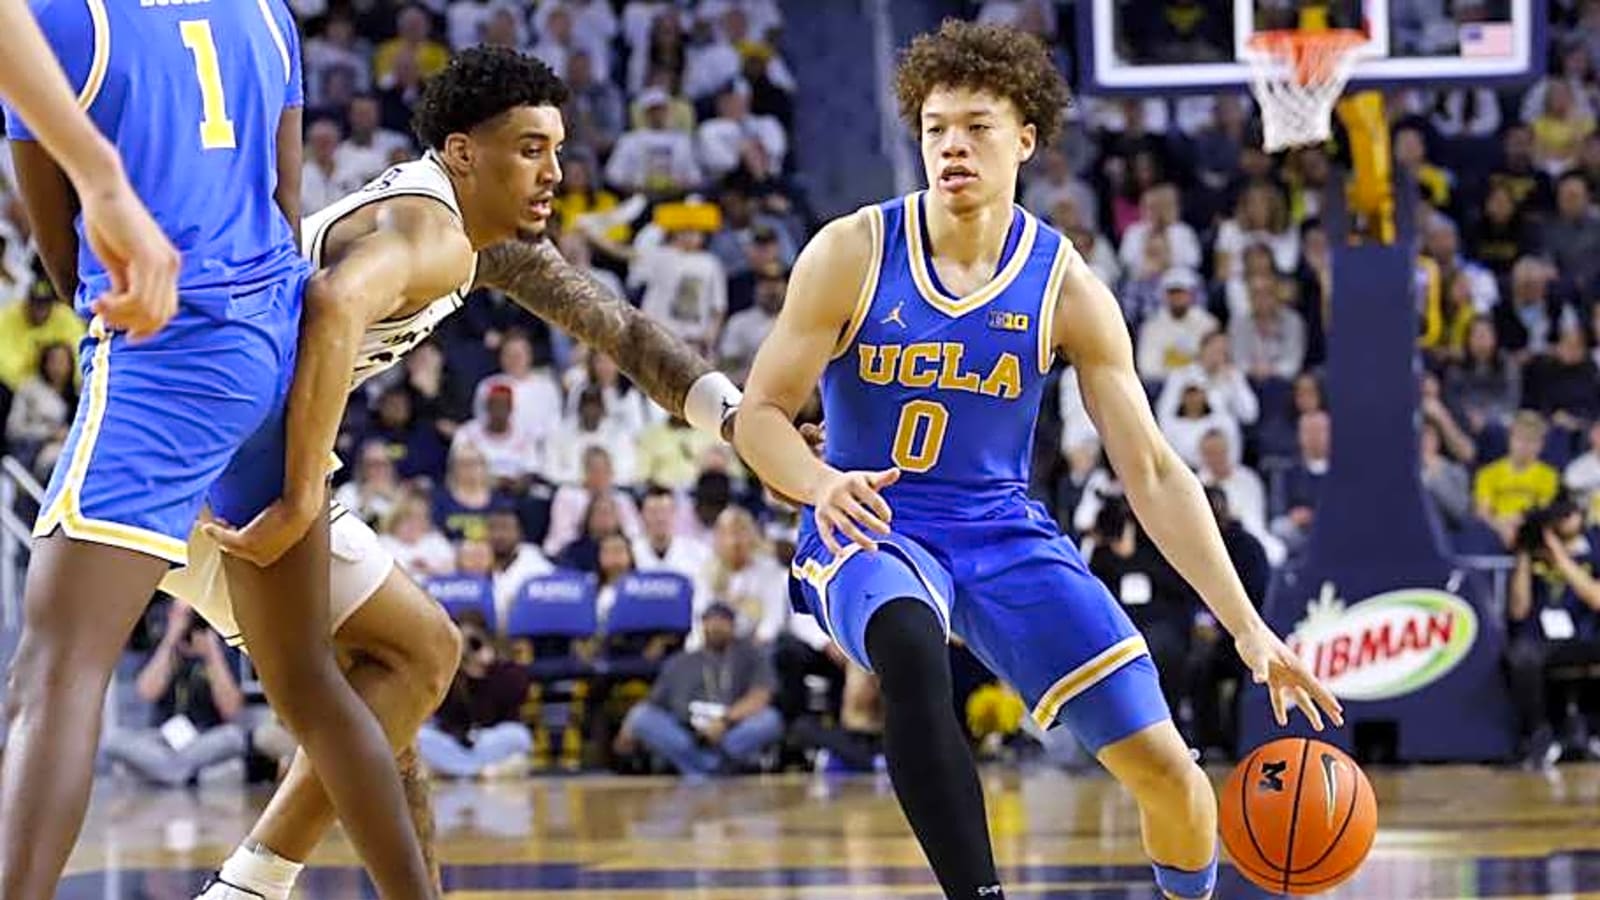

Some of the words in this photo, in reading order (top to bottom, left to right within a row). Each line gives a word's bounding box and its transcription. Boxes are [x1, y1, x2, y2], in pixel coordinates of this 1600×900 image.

[179, 19, 236, 149] 1
[858, 342, 1022, 399] UCLA
[892, 399, 949, 473] 0
